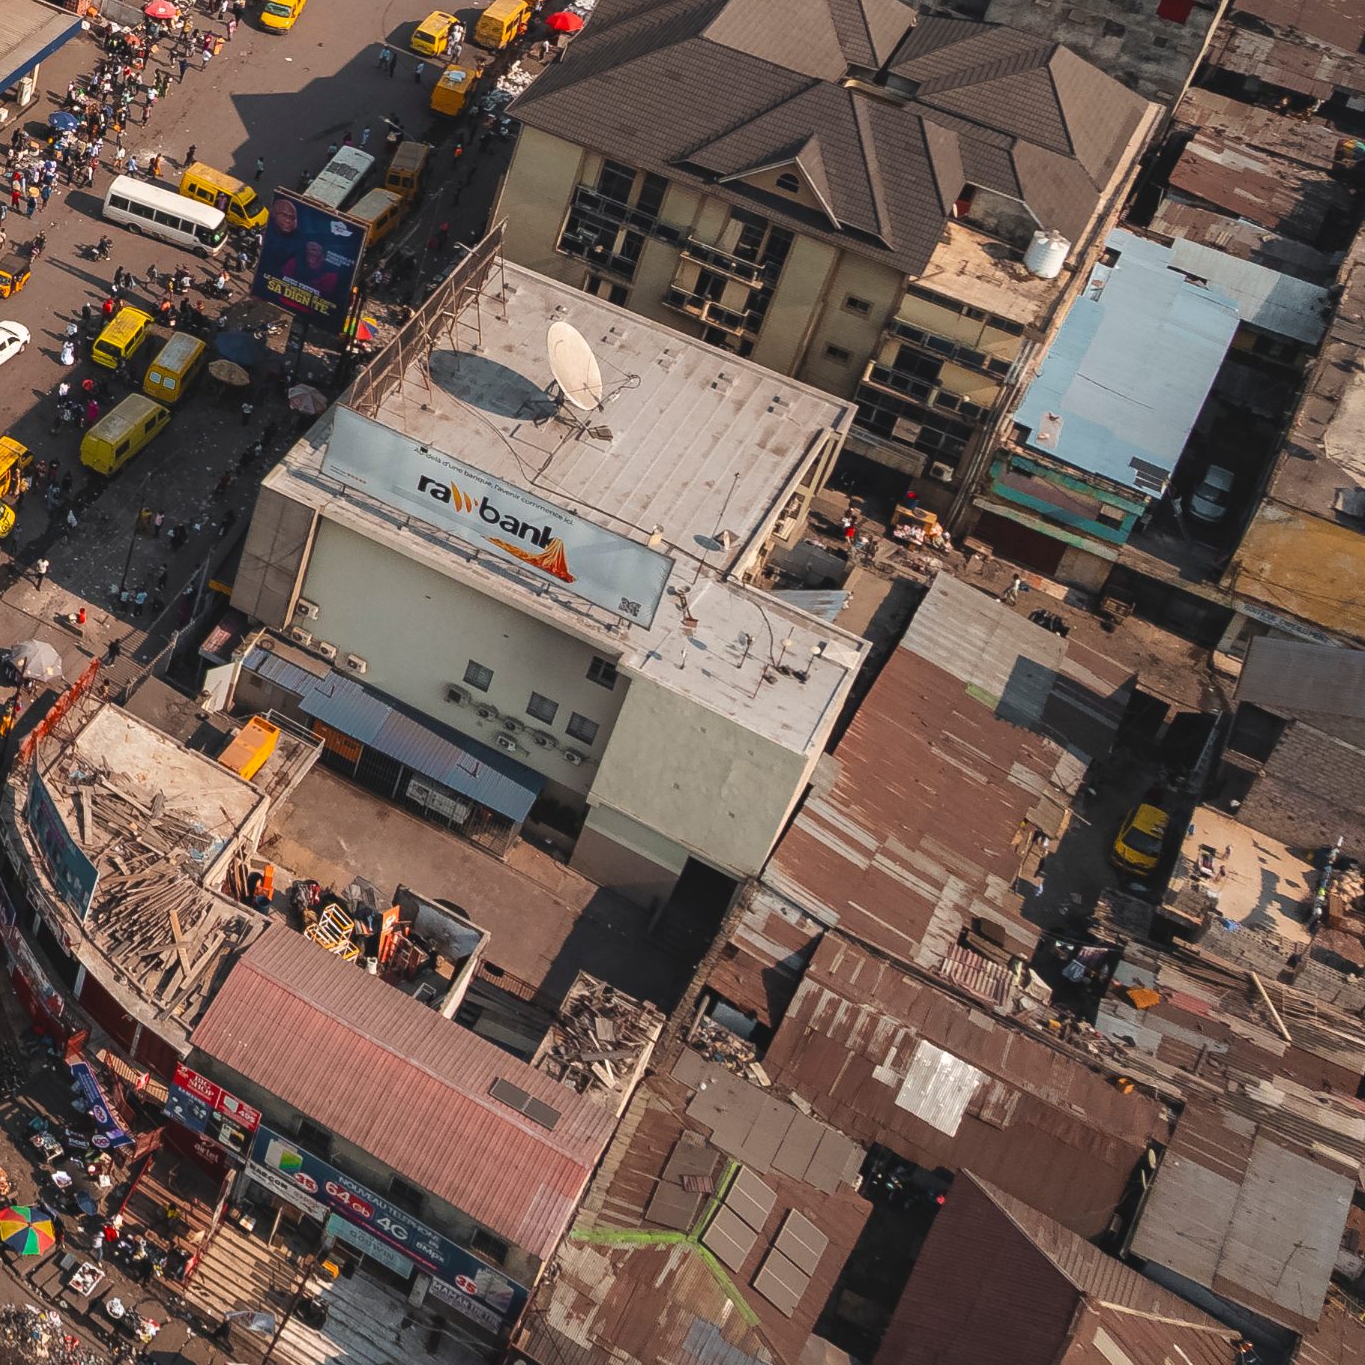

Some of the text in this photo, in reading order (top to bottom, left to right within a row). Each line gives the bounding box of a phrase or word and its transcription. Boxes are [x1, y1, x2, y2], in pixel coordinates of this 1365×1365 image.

[267, 280, 281, 294] SA
[442, 460, 463, 474] d'une
[463, 469, 493, 488] banque,
[493, 483, 521, 501] l'avenir
[520, 496, 564, 519] commence
[188, 1078, 215, 1097] SHOP
[194, 1075, 211, 1090] BIG
[295, 1174, 315, 1191] 35
[325, 1181, 350, 1205] 64
[338, 1176, 387, 1211] NOUVEAU
[377, 1218, 408, 1241] 4G
[456, 1276, 477, 1294] 35
